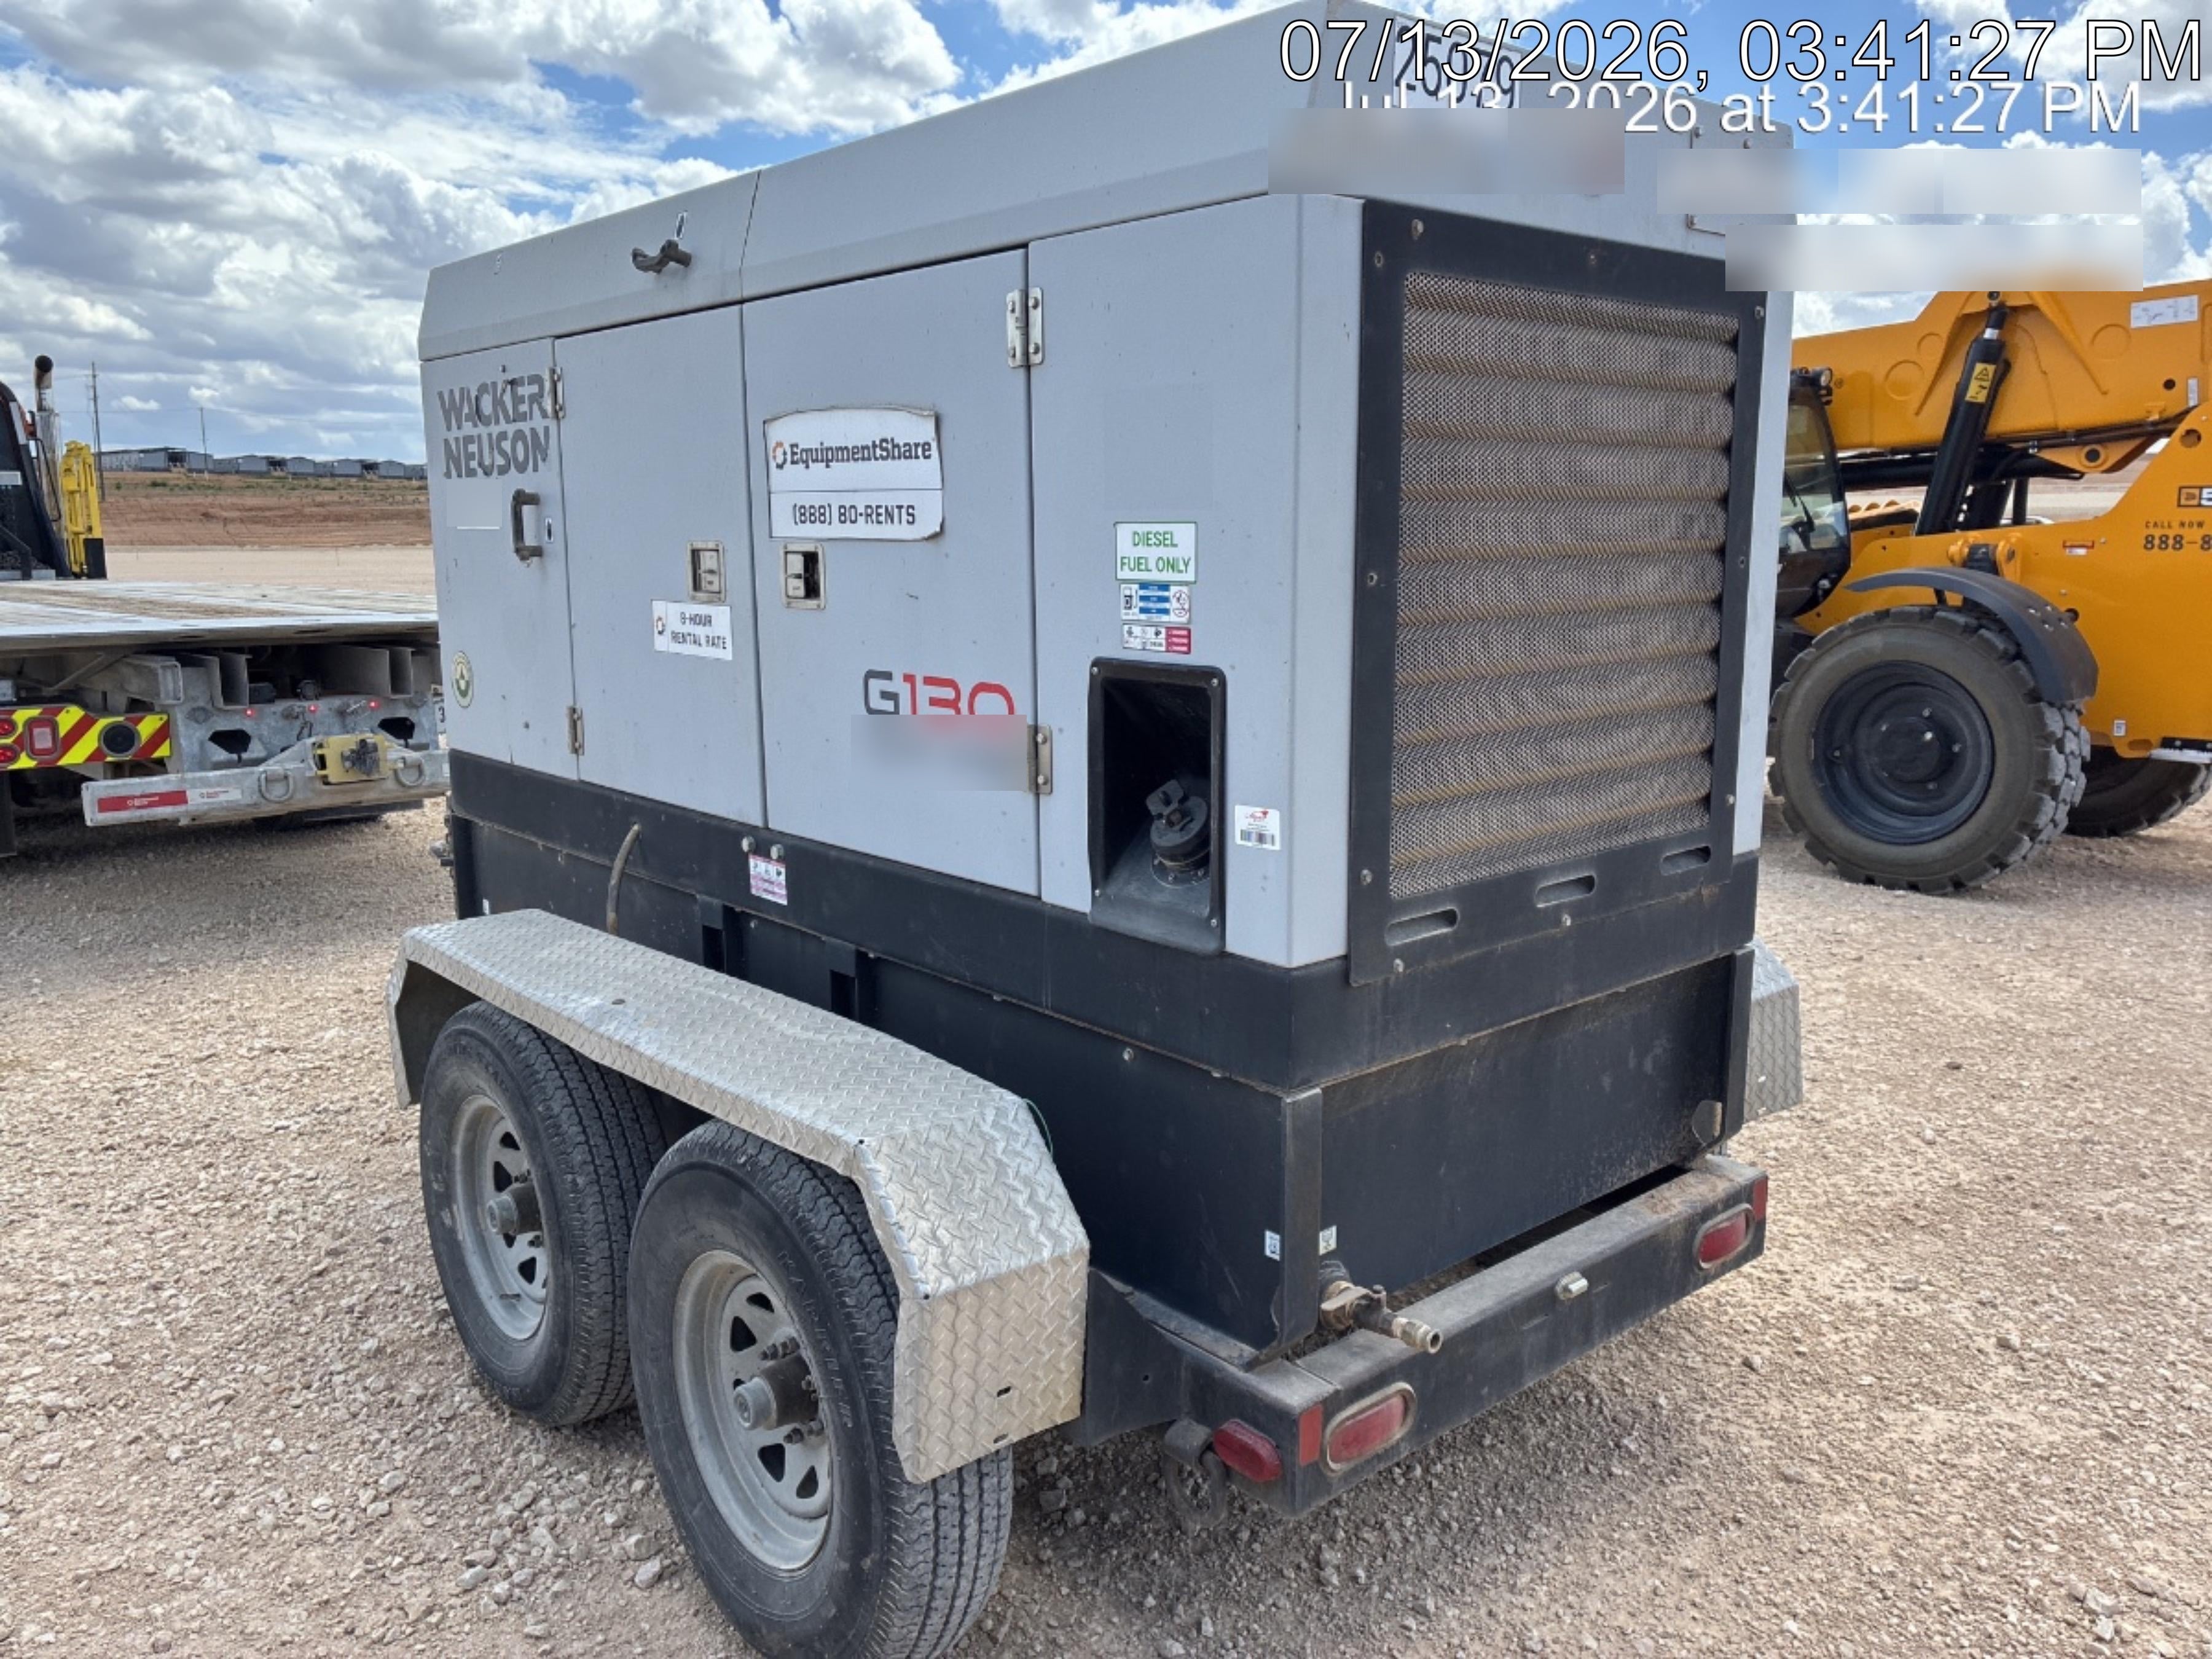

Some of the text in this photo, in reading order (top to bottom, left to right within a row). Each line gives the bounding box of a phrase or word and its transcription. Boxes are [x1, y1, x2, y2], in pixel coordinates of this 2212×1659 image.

[437, 374, 551, 432] WACKER
[444, 425, 550, 480] NEUSON
[790, 437, 932, 469] EquipmentShare
[793, 503, 832, 525] (888)
[1132, 530, 1179, 547] DIESEL
[1120, 555, 1191, 574] FUEL ONLY
[670, 630, 703, 647] RENTAL
